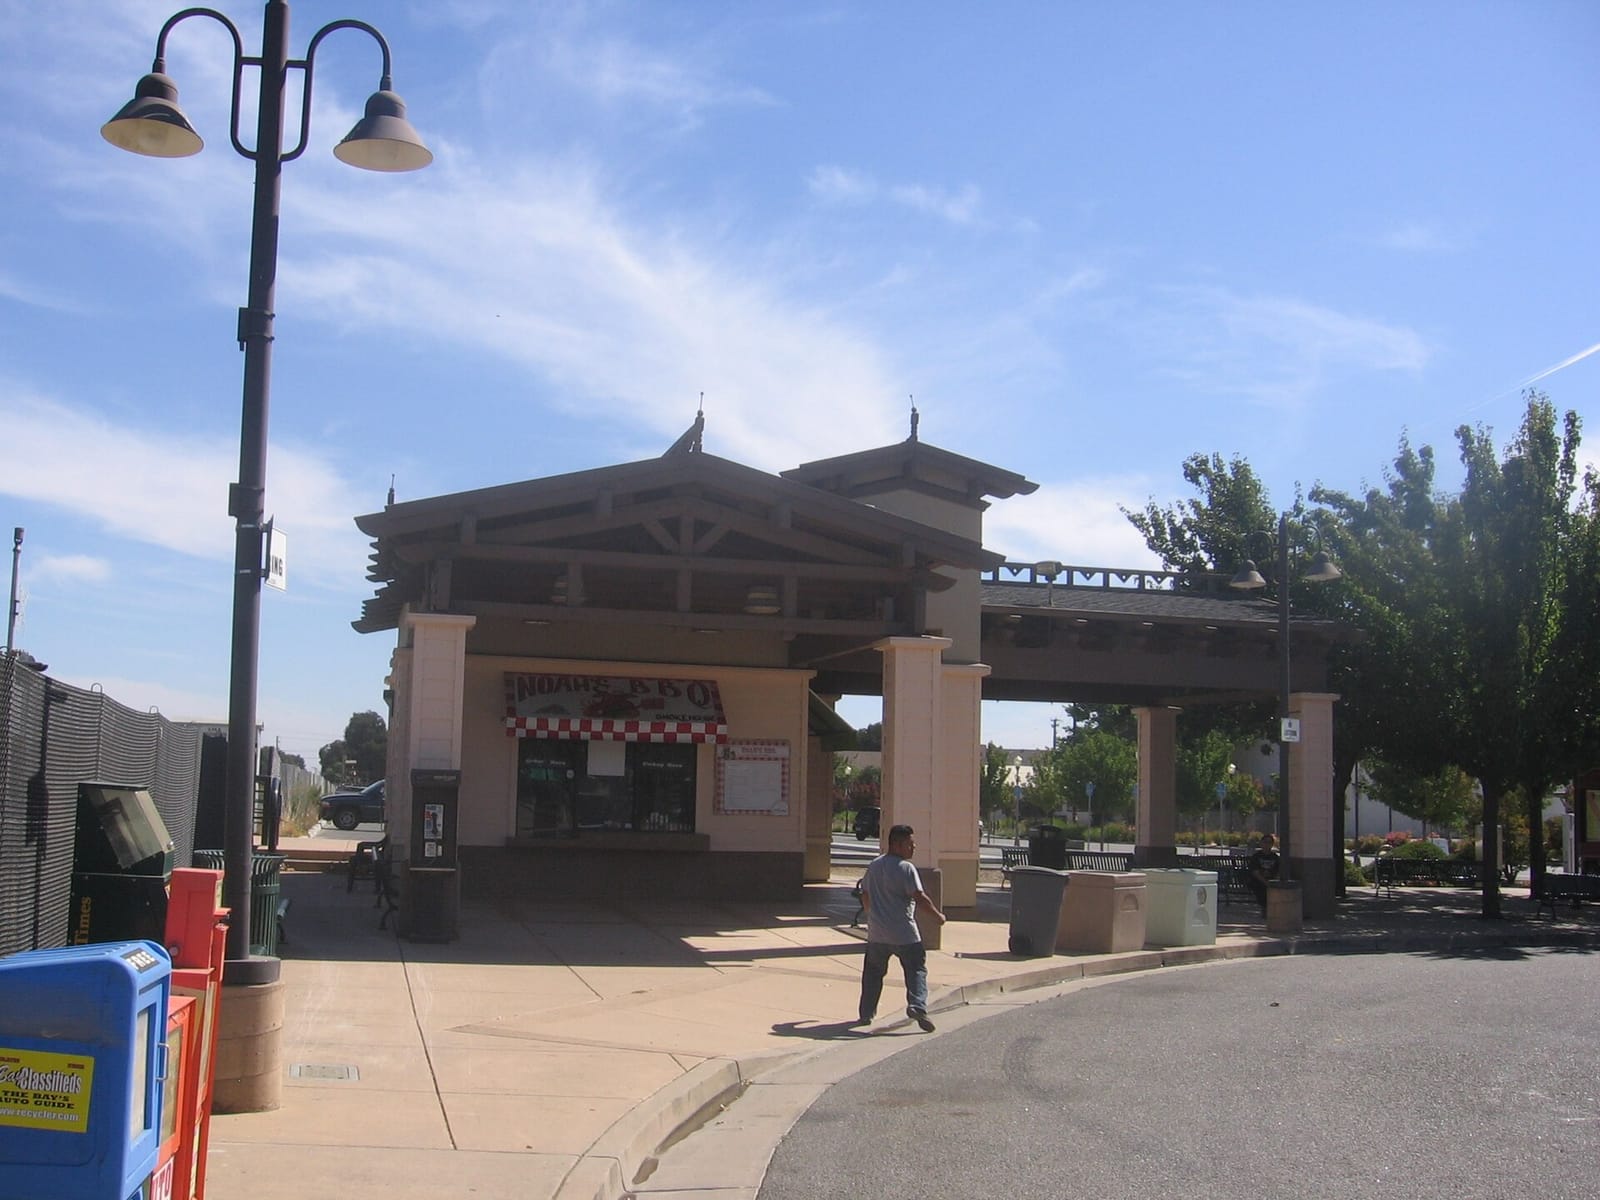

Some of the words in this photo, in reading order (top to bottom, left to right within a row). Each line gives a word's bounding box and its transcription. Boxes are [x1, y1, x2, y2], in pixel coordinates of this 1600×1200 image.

[75, 896, 91, 944] Times
[124, 951, 157, 970] FREE
[2, 1090, 28, 1098] THE
[33, 1093, 70, 1102] BAY'S
[34, 1100, 75, 1109] GUIDE
